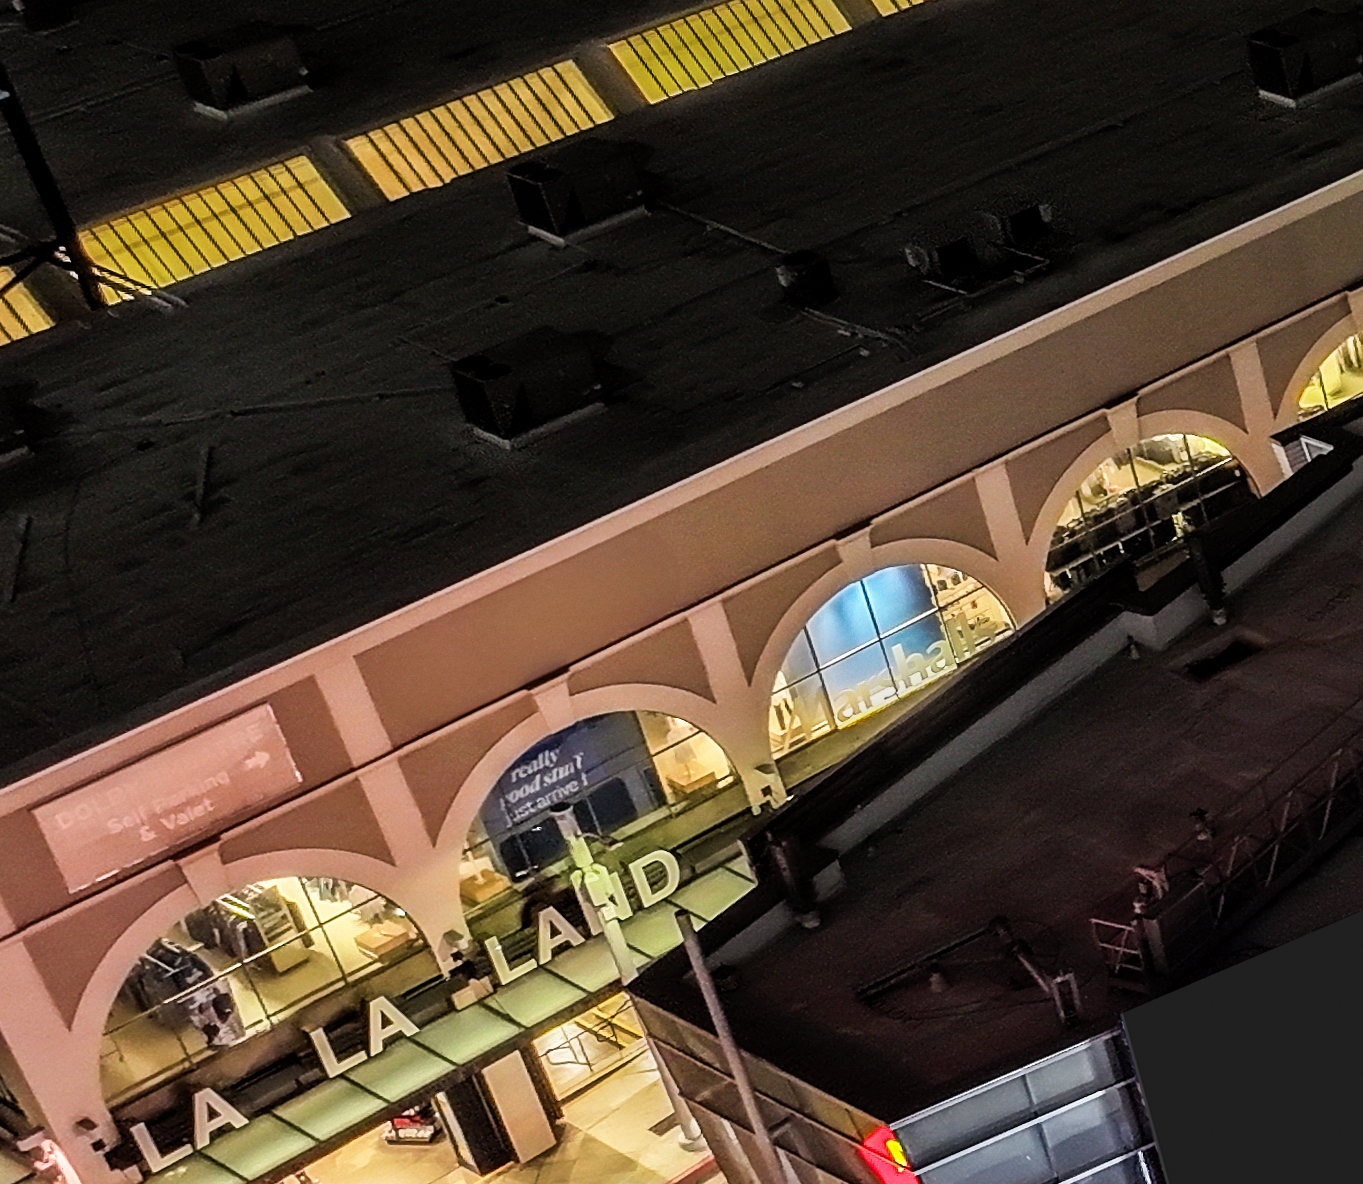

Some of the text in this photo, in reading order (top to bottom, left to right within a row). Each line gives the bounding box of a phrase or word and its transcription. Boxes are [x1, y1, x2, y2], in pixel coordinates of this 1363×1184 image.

[510, 748, 561, 783] really
[107, 803, 147, 835] Self
[138, 798, 215, 843] & Valet
[130, 1087, 250, 1174] LA
[309, 996, 421, 1079] LA
